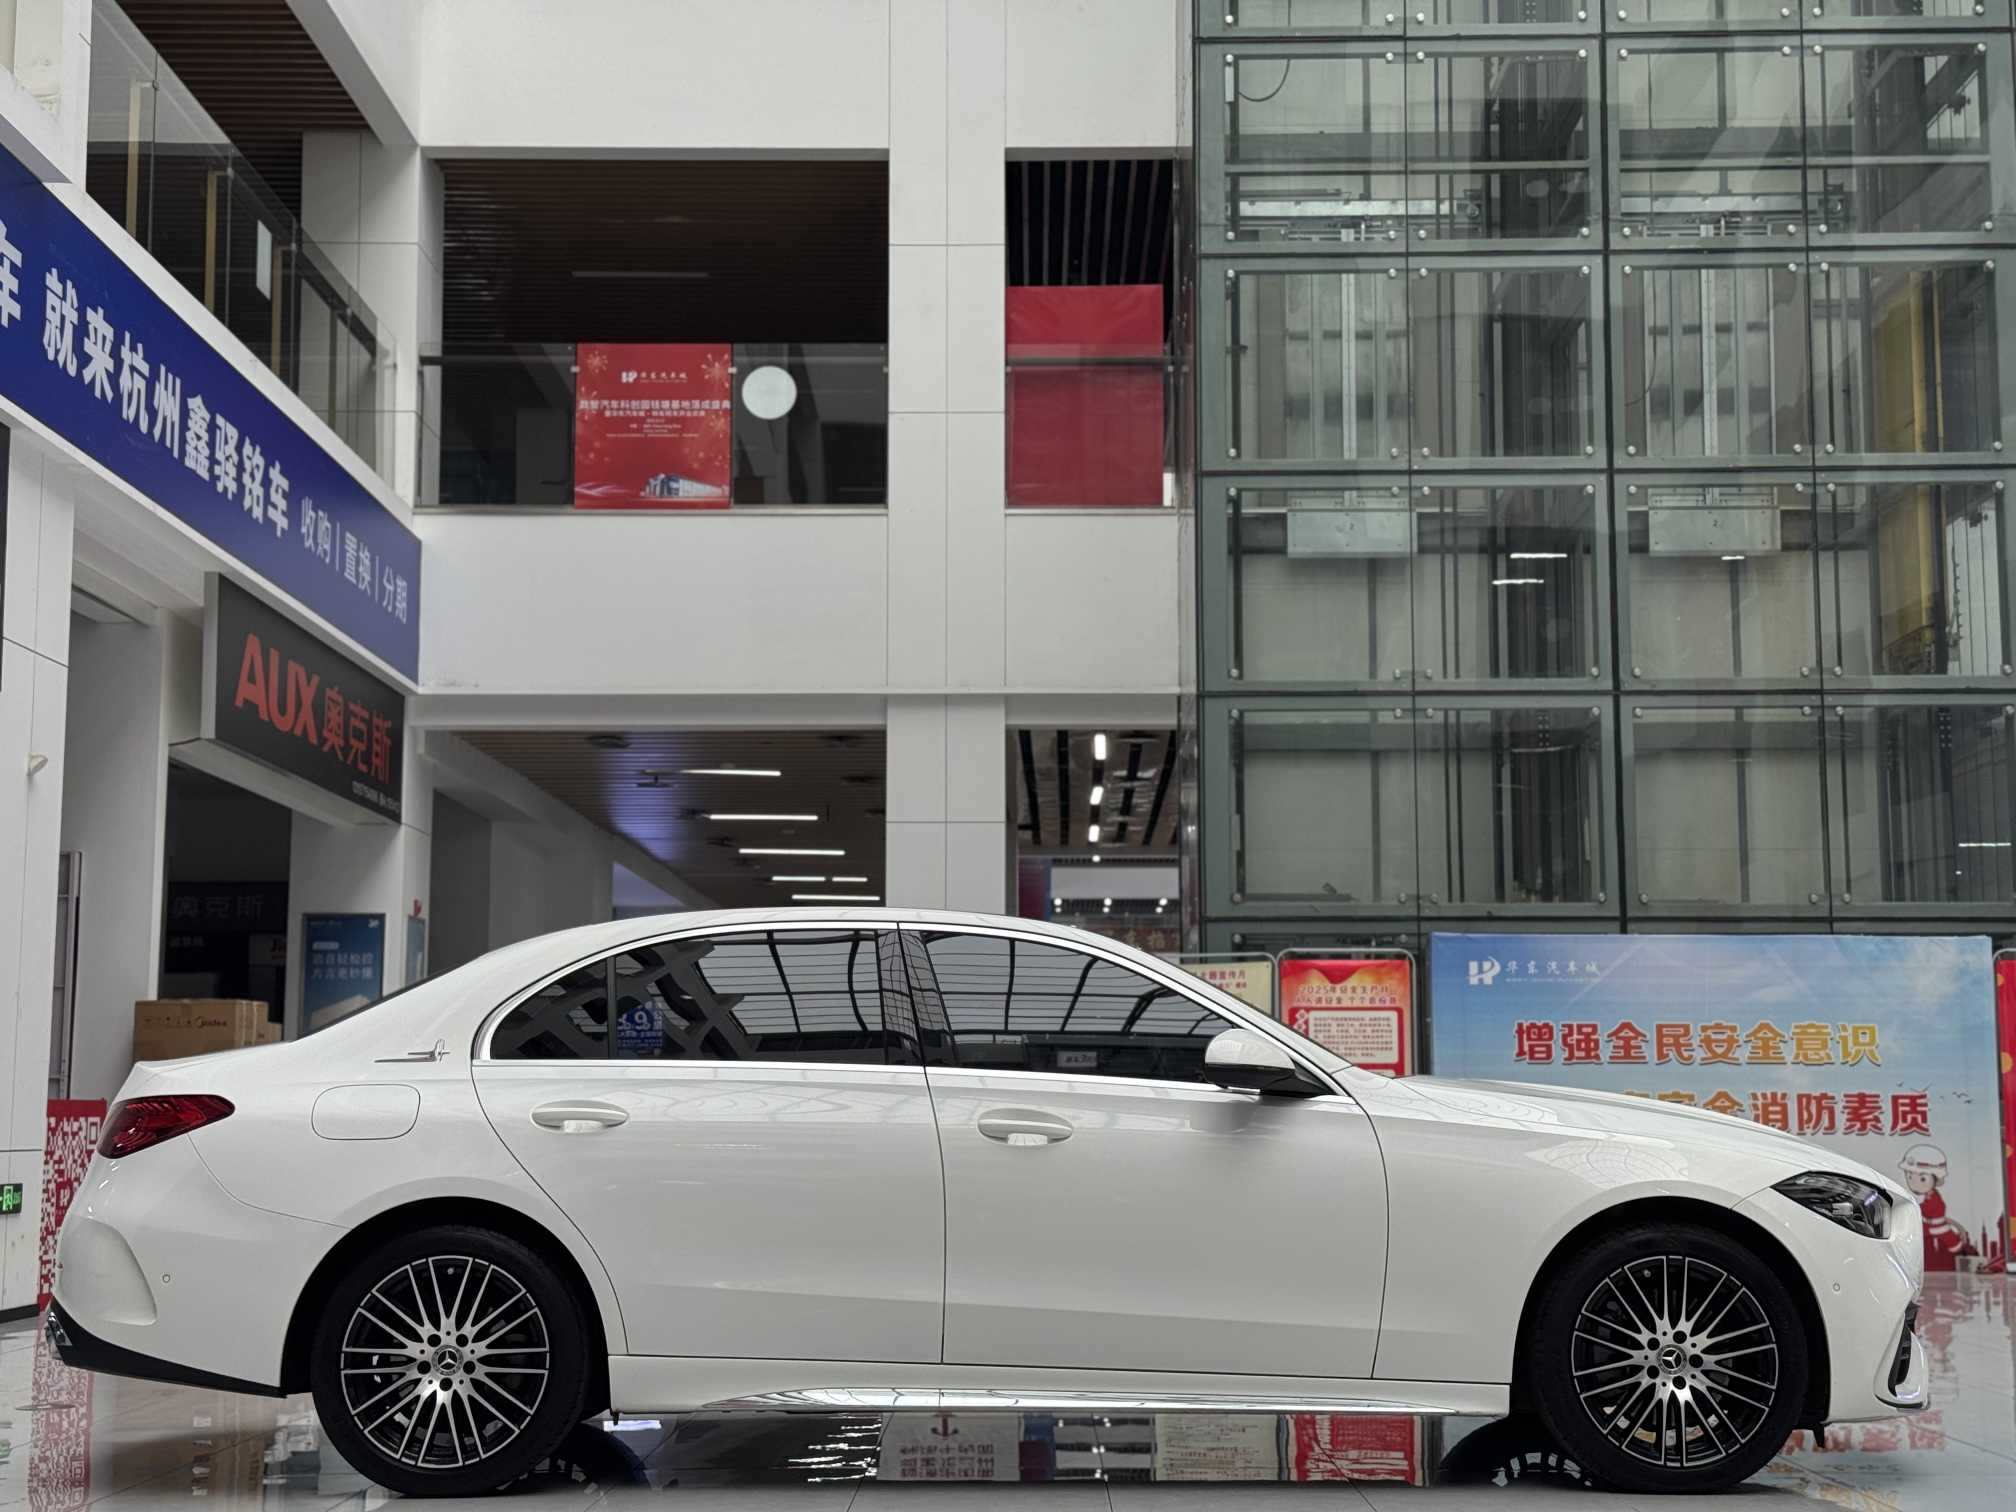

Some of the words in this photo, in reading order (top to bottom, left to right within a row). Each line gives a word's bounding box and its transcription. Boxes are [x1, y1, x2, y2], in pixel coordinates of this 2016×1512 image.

[234, 632, 321, 746] AUX
[321, 685, 393, 785] 奥克斯
[1514, 1021, 1882, 1065] 增强全民安全意识
